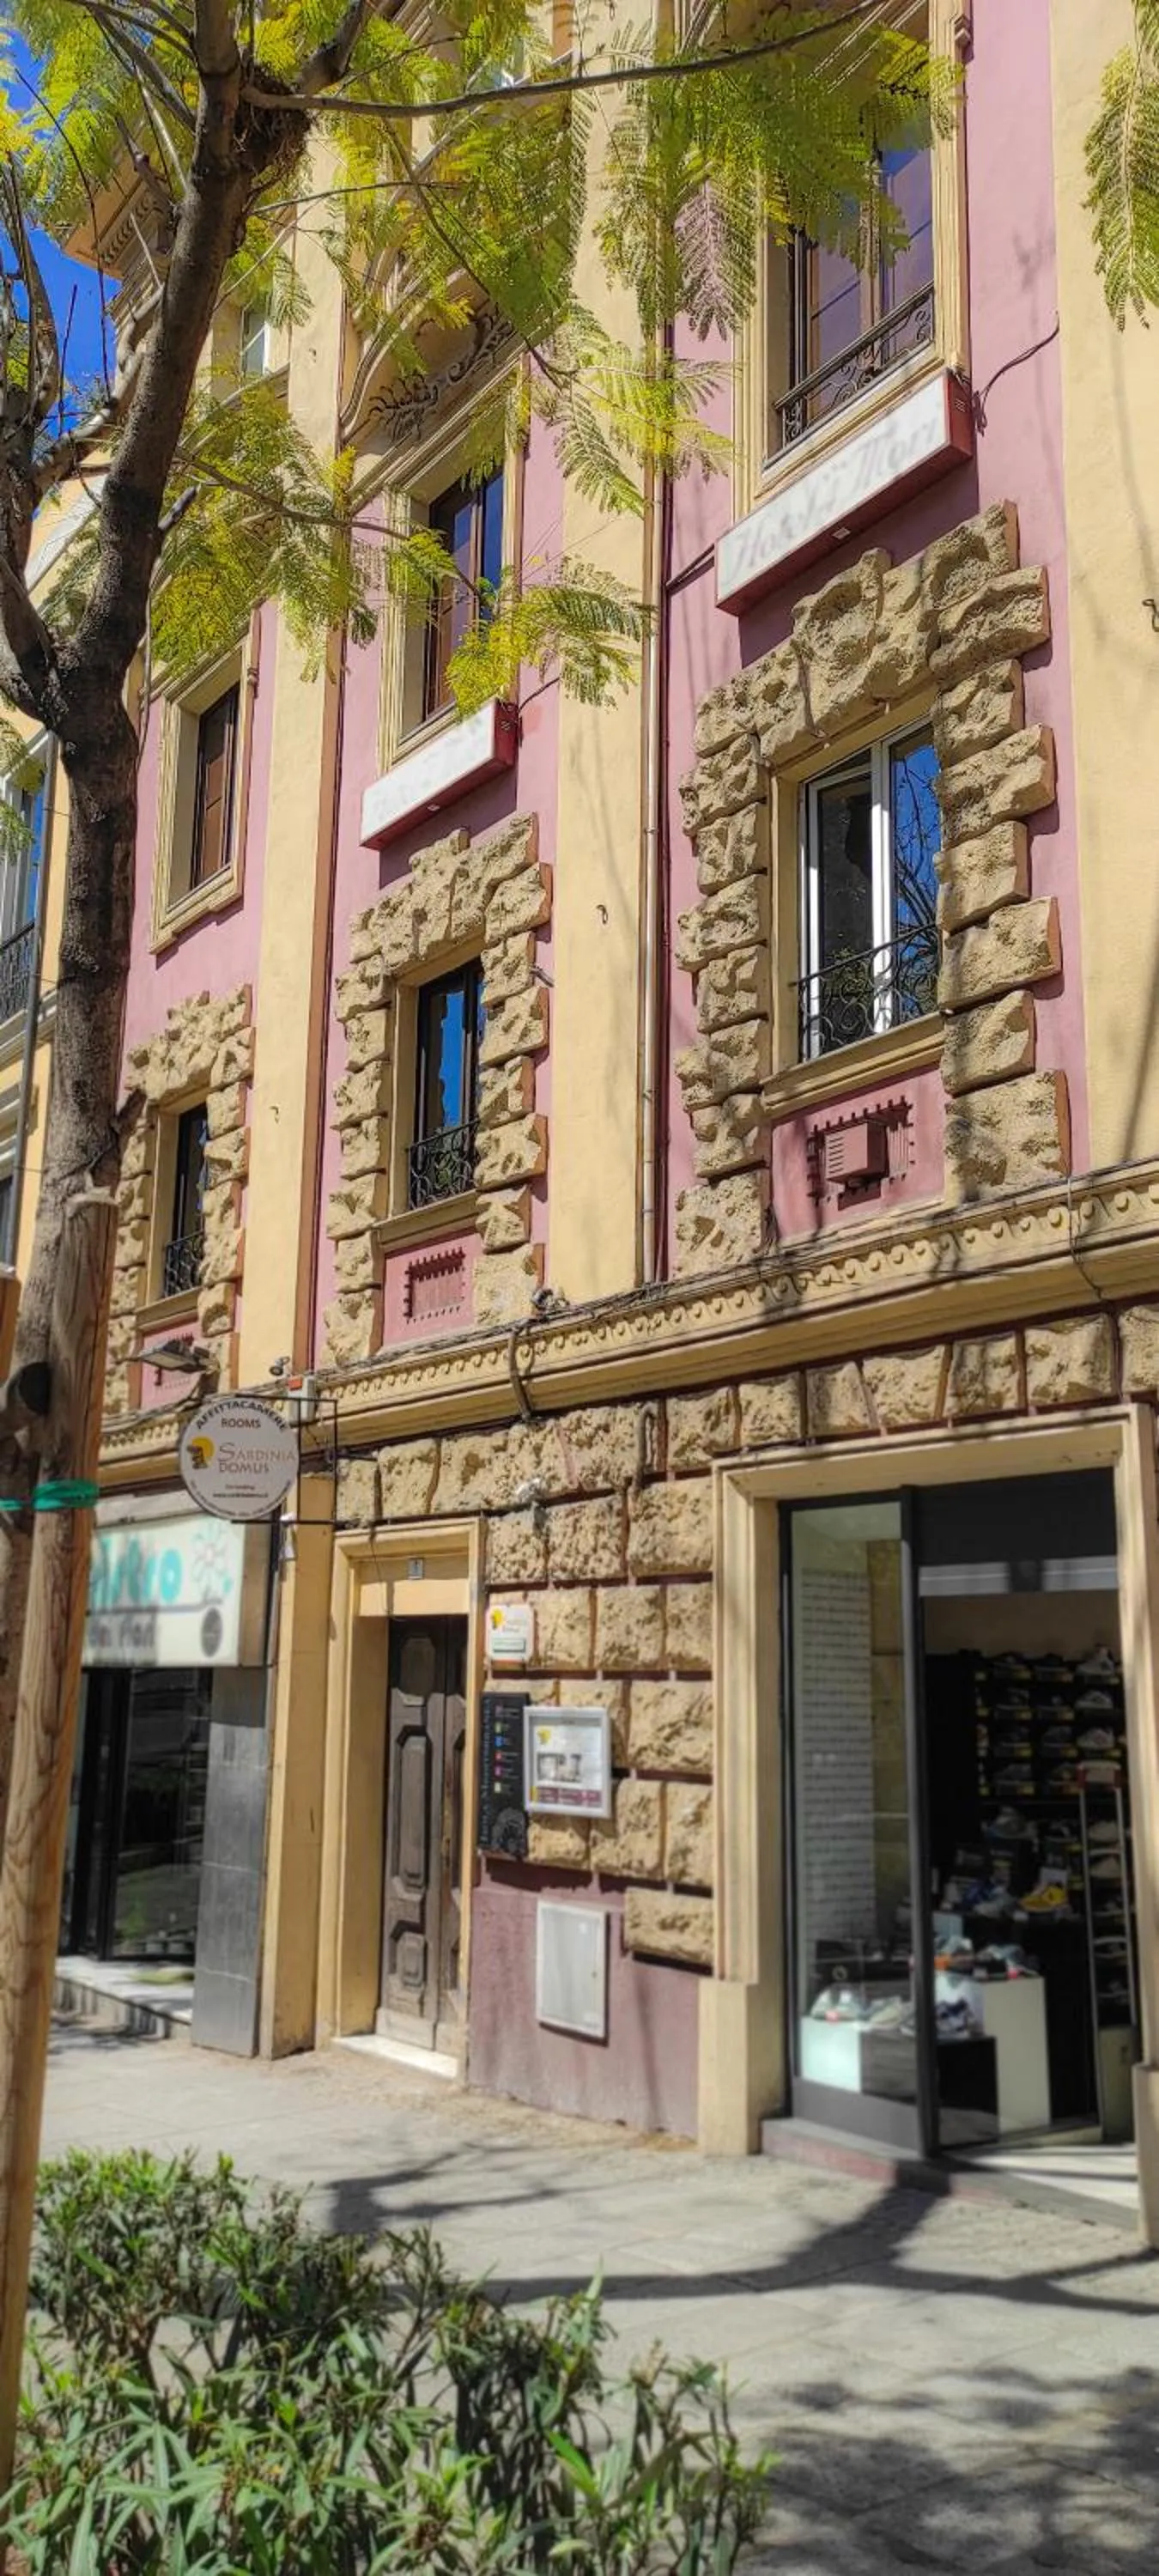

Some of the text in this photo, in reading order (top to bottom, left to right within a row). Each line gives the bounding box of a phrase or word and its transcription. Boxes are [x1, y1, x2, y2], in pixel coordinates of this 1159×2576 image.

[196, 1400, 288, 1431] AFFITTACAMERE
[221, 1418, 261, 1428] ROOMS
[218, 1442, 295, 1461] SARDINIA
[218, 1462, 270, 1474] DOMUS
